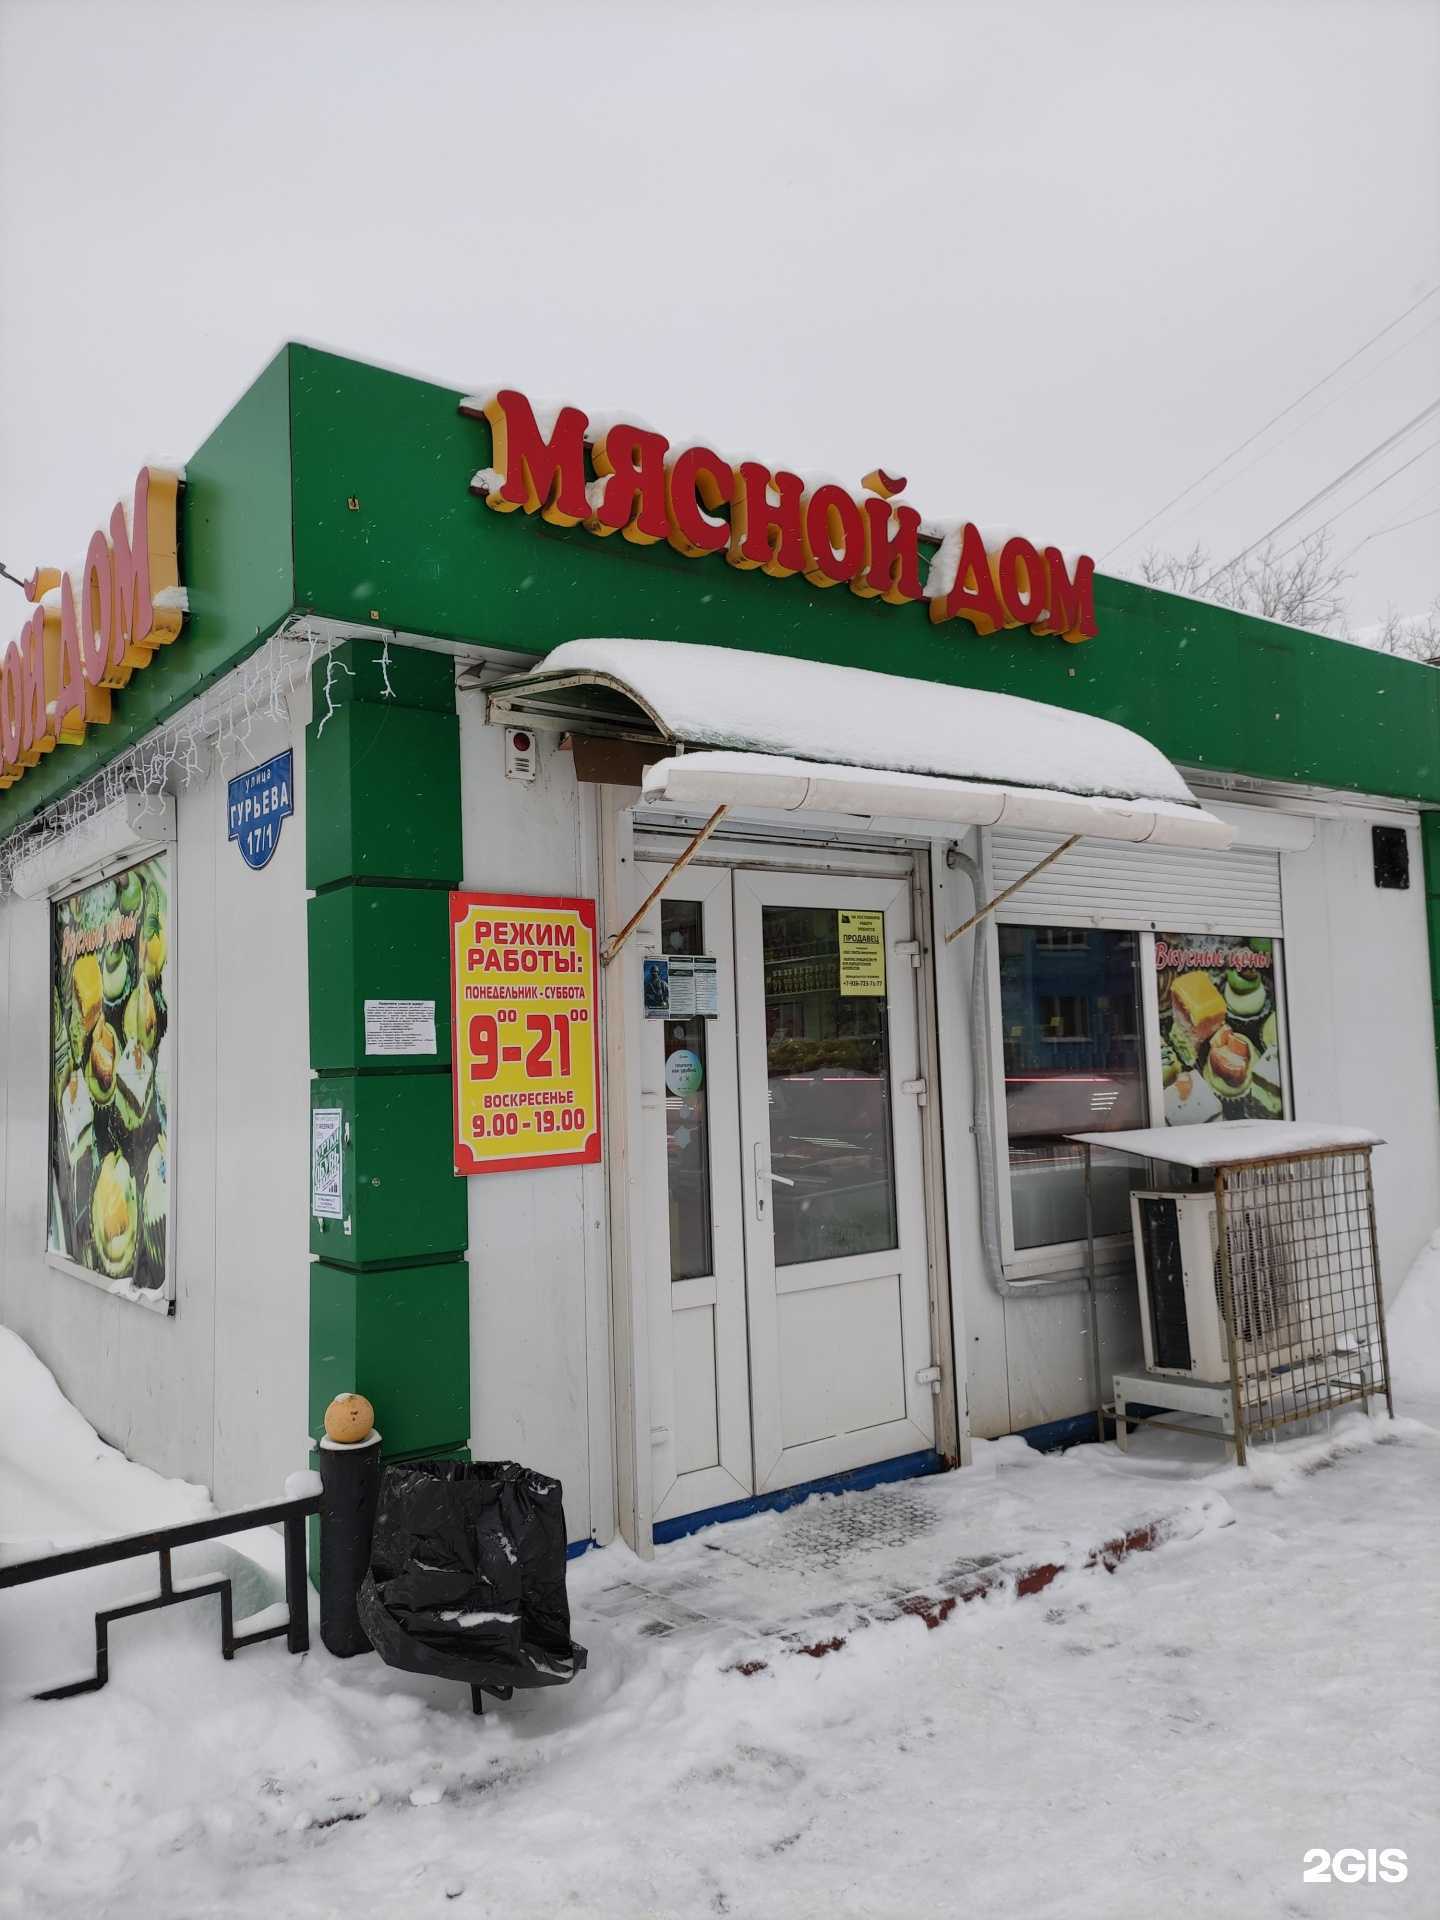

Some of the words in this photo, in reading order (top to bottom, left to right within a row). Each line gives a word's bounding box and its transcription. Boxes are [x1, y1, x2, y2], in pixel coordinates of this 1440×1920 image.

[492, 388, 923, 603] МЯСНОЙ
[938, 521, 1098, 642] ДОМ
[54, 465, 162, 742] ДОМ
[245, 768, 272, 794] улица
[230, 781, 289, 829] ГУРЬЕВА
[246, 823, 273, 855] 17/1
[474, 921, 576, 947] РЕЖИМ
[843, 934, 880, 944] ПРОДАВЕЦ
[467, 948, 583, 973] РАБОТЫ:
[1154, 941, 1224, 972] Вкусные
[1228, 949, 1273, 972] цены
[483, 1090, 575, 1109] ВОСКРЕСЕНЬЕ
